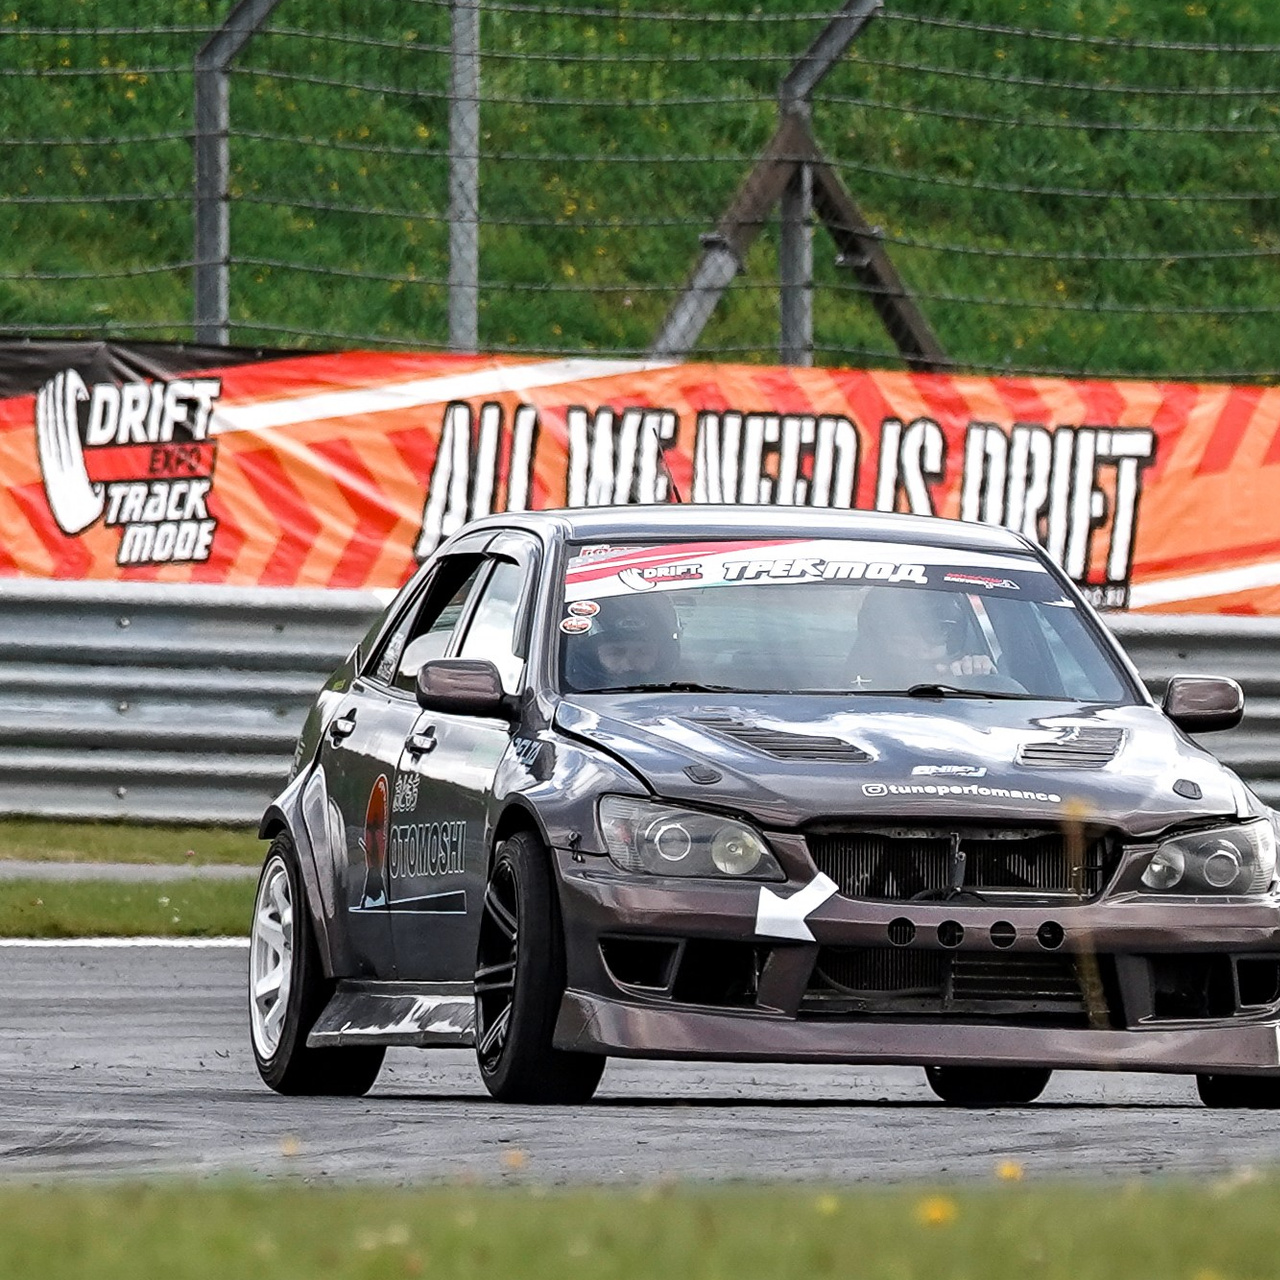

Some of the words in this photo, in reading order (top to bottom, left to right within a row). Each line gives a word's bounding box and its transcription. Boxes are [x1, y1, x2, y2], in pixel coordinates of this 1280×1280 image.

[86, 380, 221, 446] DRIFT
[690, 412, 859, 509] NEED
[874, 417, 945, 517] IS
[961, 424, 1153, 582] DRIFT
[117, 521, 216, 565] MODE
[642, 563, 703, 580] DRIFT
[390, 820, 467, 880] OTOMOSHI
